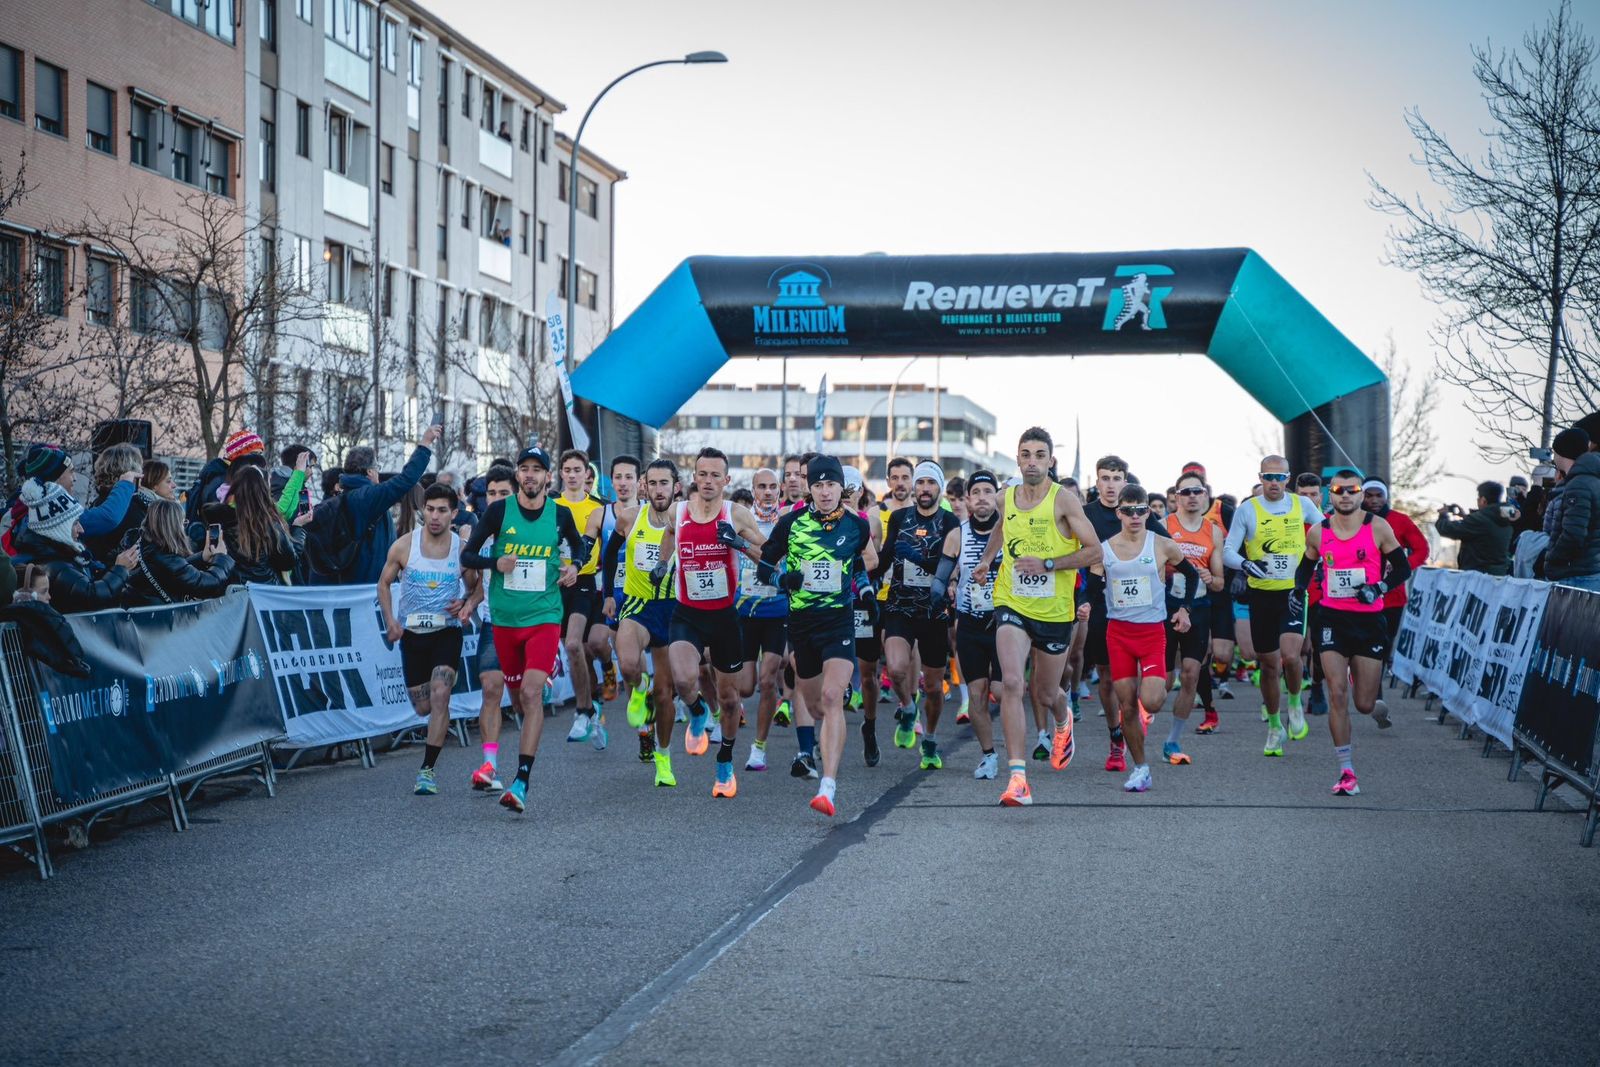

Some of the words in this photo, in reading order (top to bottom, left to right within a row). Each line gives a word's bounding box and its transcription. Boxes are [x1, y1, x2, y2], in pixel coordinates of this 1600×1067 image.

[902, 277, 1106, 311] RenuevaT
[753, 305, 847, 333] MILENIUM
[941, 314, 993, 325] PERFORMANCE
[1005, 313, 1032, 323] HEALTH
[1034, 312, 1061, 323] CENTER
[958, 326, 1047, 336] WWW.RENUEVAT.ES
[695, 543, 728, 551] ALTACASA
[646, 550, 660, 561] 25
[1274, 560, 1288, 570] 35
[522, 569, 528, 579] 1
[617, 569, 627, 578] 5
[813, 569, 830, 580] 23
[699, 578, 715, 589] 34
[1018, 574, 1048, 585] 1699
[1339, 577, 1352, 587] 31
[983, 590, 994, 600] 6
[1123, 586, 1139, 596] 46
